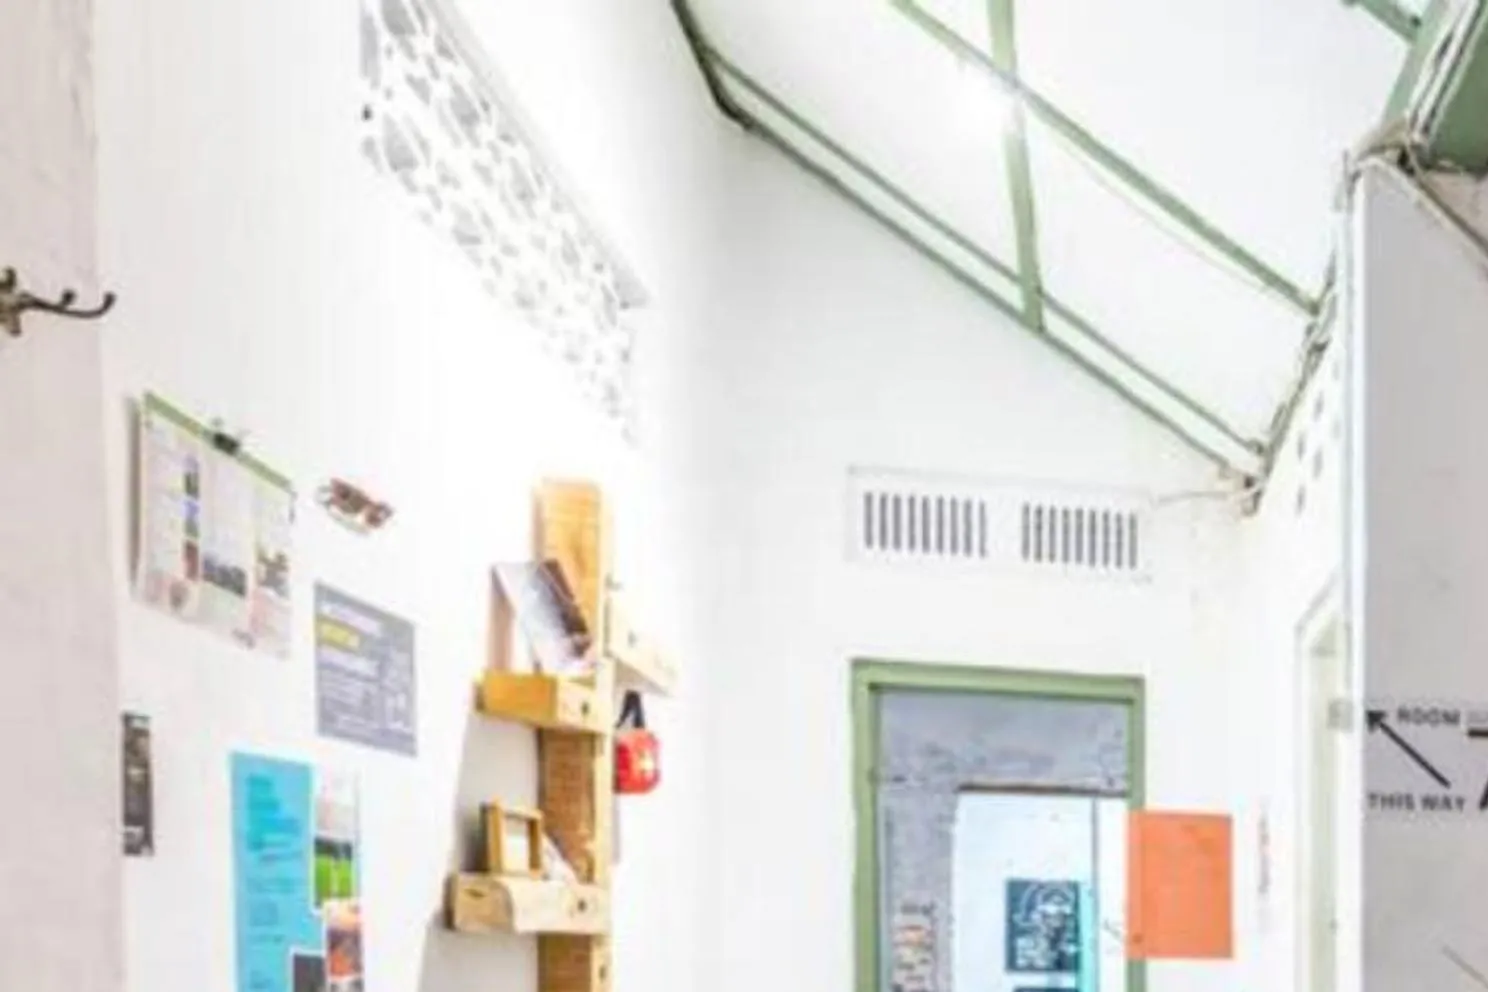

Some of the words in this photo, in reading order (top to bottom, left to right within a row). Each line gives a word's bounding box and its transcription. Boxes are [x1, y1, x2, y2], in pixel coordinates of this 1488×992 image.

[1397, 706, 1461, 727] ROOM
[1367, 793, 1415, 812] THIS
[1420, 794, 1465, 813] WAY
